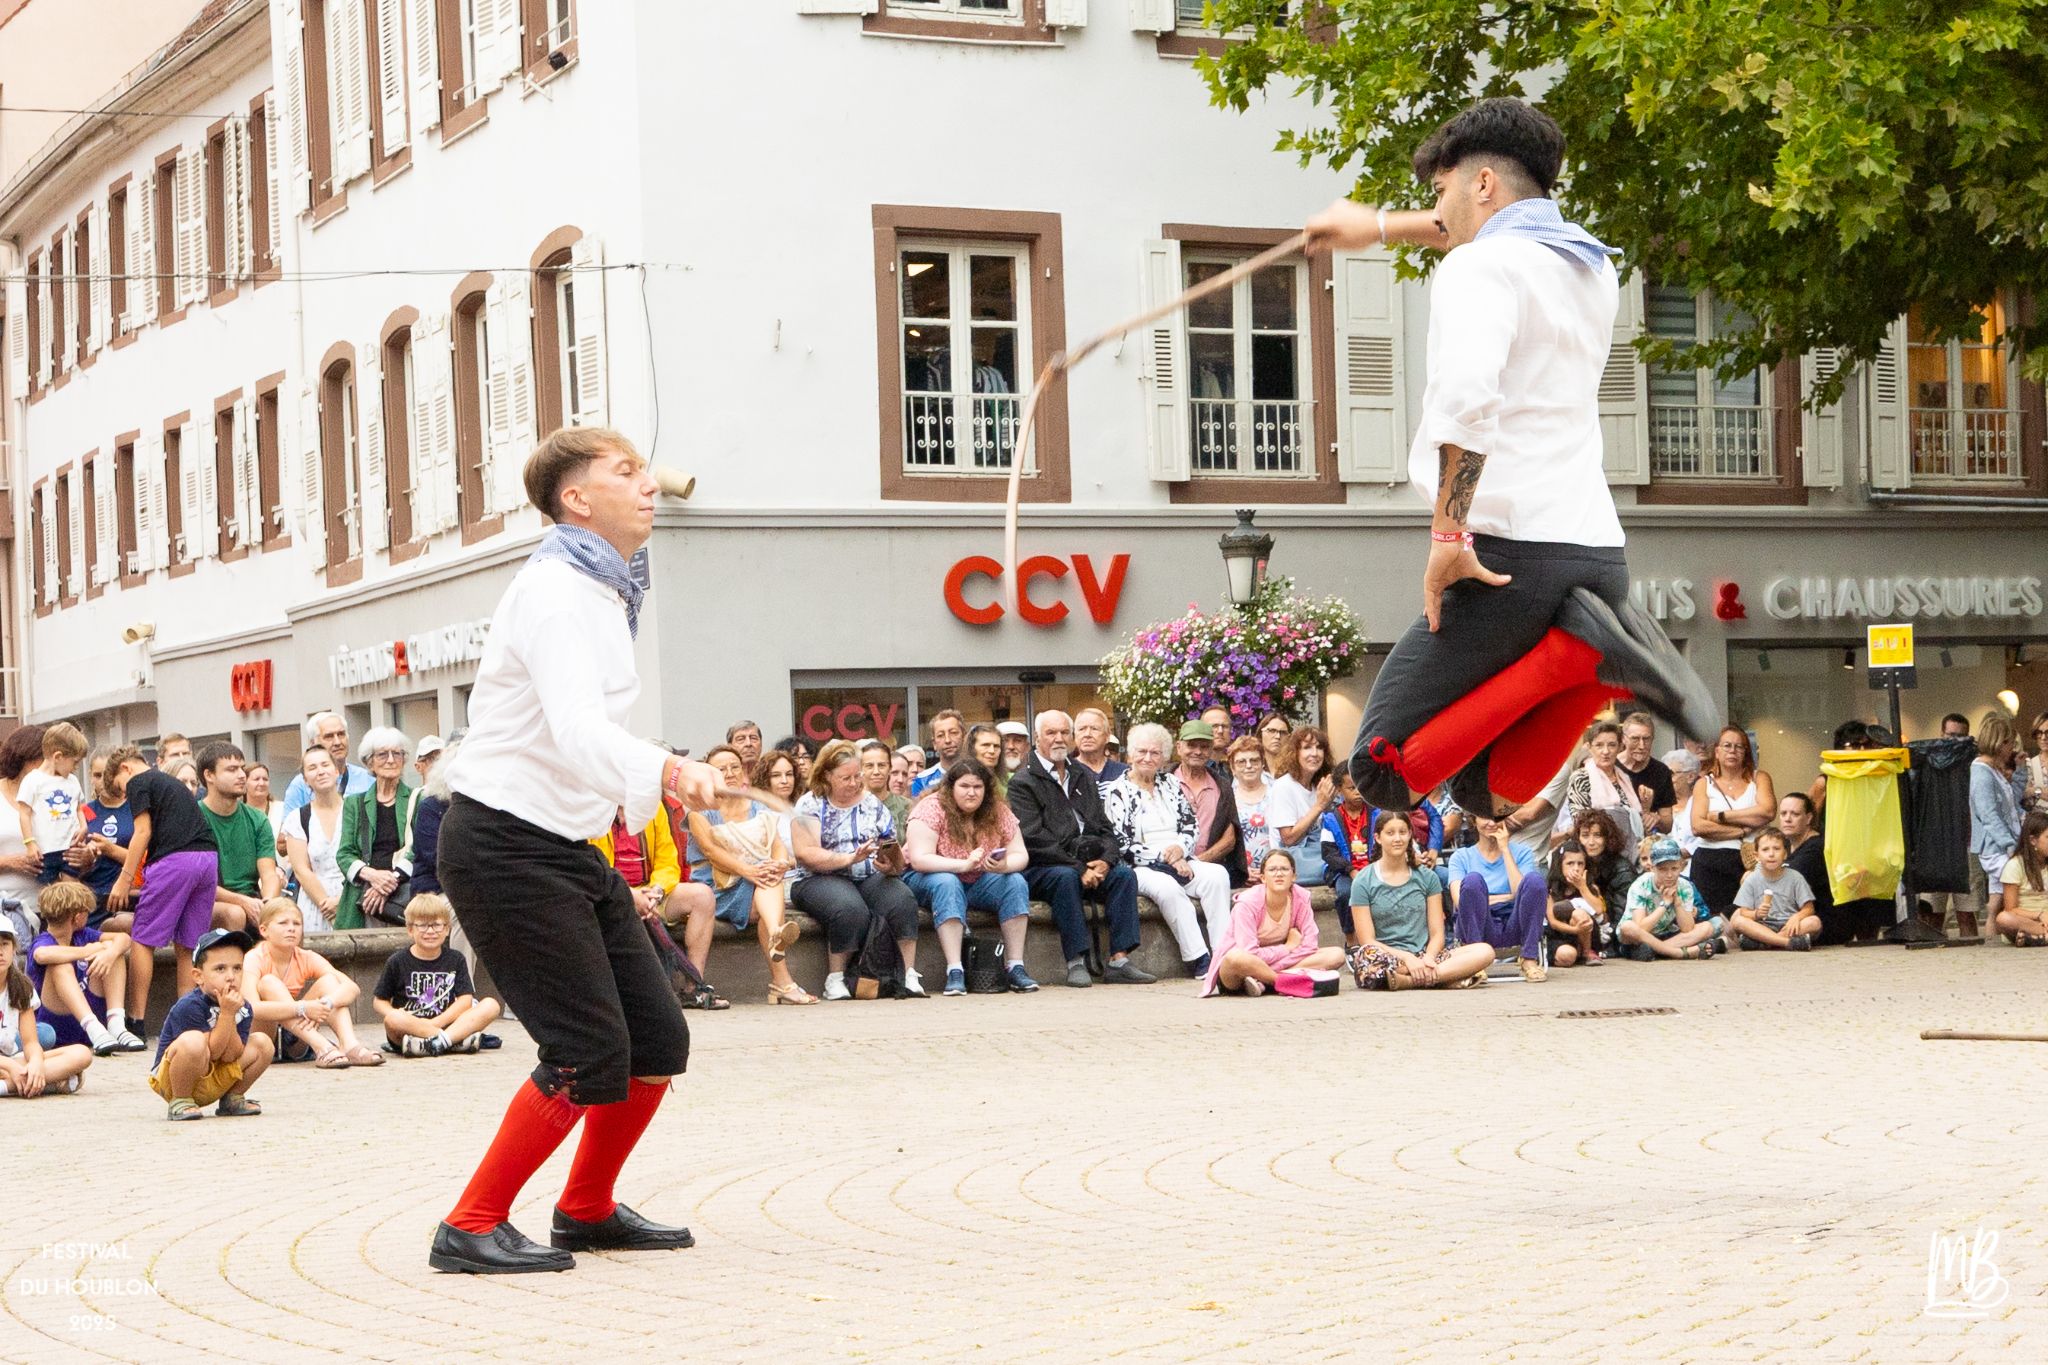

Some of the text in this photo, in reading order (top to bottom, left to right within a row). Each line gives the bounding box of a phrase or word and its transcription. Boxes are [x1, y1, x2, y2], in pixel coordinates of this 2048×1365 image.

[944, 554, 1131, 624] CCV
[1715, 581, 1747, 621] &
[1764, 577, 2044, 620] CHAUSSURES
[802, 704, 898, 742] CCV
